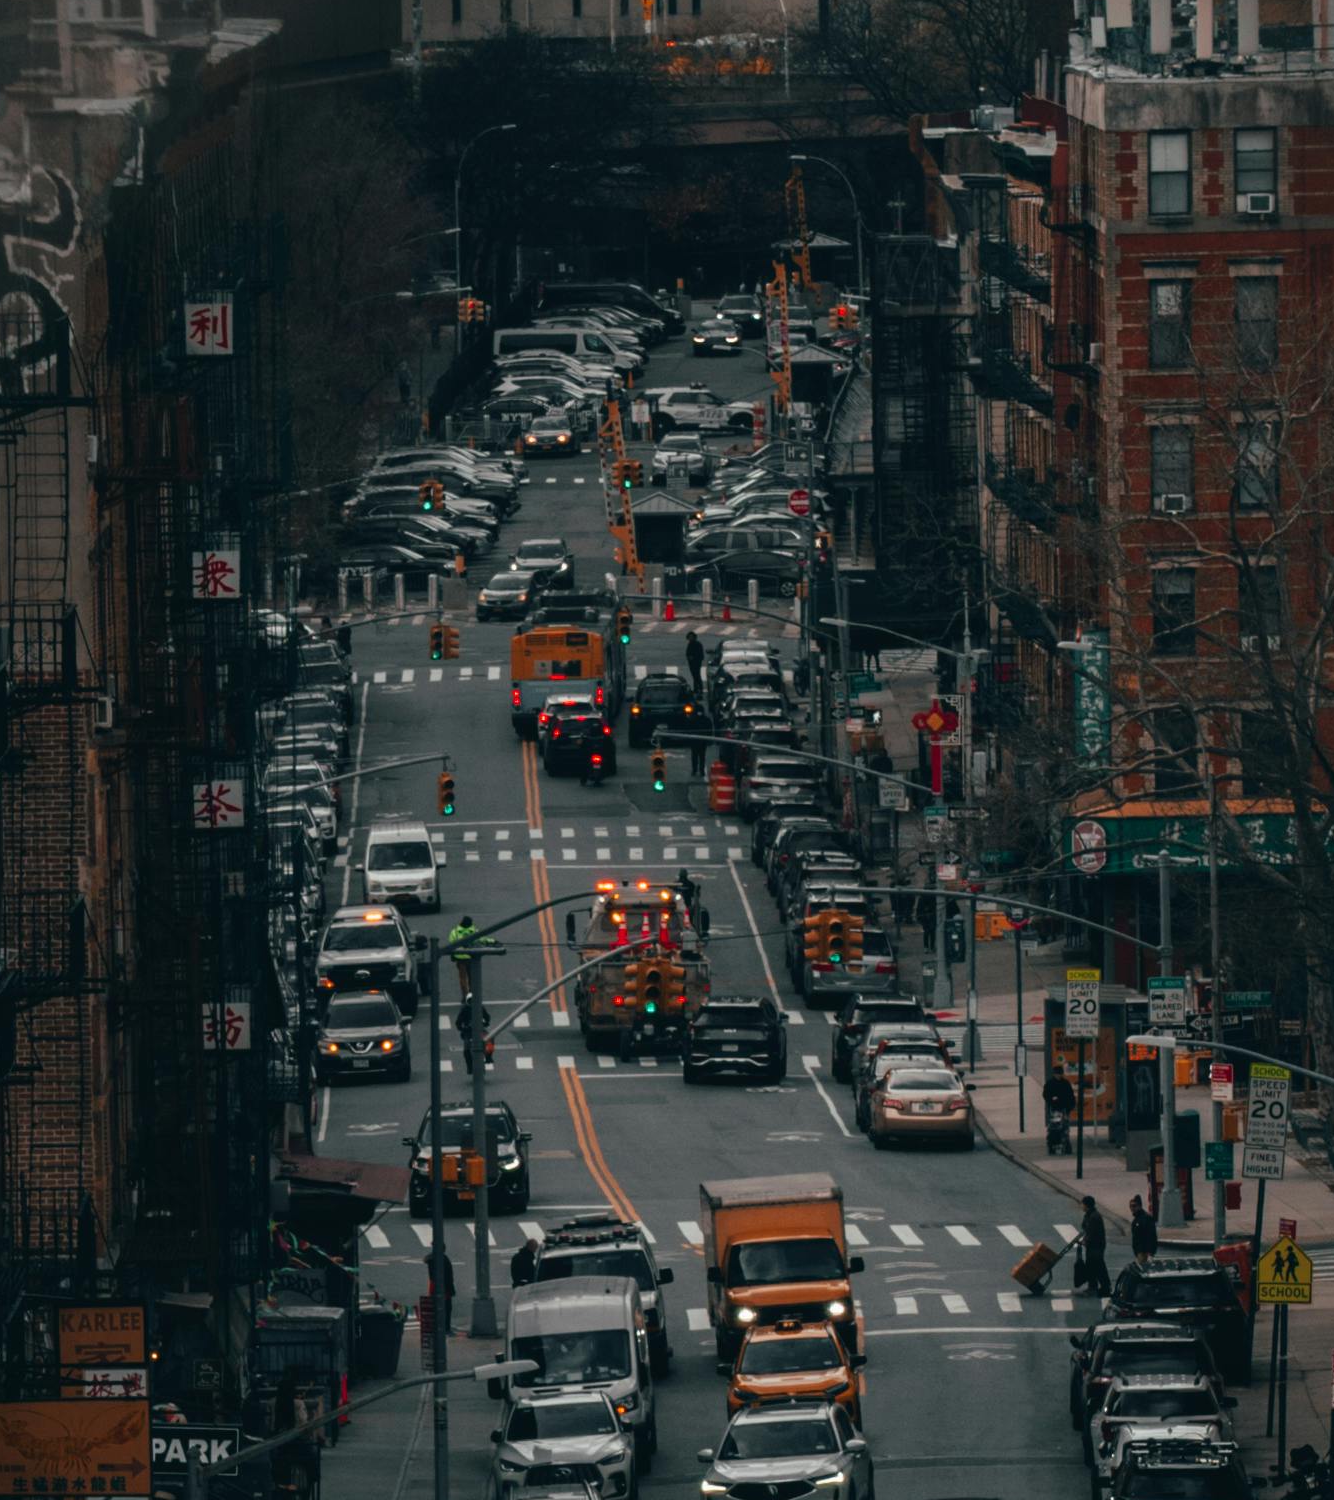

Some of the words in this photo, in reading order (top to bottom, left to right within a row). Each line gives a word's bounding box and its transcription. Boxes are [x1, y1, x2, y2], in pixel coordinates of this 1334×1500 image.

[190, 305, 229, 350] 利
[1069, 971, 1098, 979] SCHOOL
[1068, 982, 1097, 990] SPEED
[1069, 999, 1097, 1015] 20
[1151, 1002, 1182, 1011] SHARED
[1156, 1011, 1177, 1020] LANE
[1253, 1065, 1287, 1078] SCHOOL
[1253, 1079, 1287, 1090] SPEED
[1255, 1090, 1282, 1099] LIMIT
[1251, 1100, 1284, 1119] 20
[1251, 1152, 1277, 1163] FINES
[1246, 1164, 1280, 1175] HIGHER
[1260, 1286, 1308, 1299] SCHOOL
[60, 1311, 141, 1333] KARLEE
[153, 1436, 234, 1465] PARK
